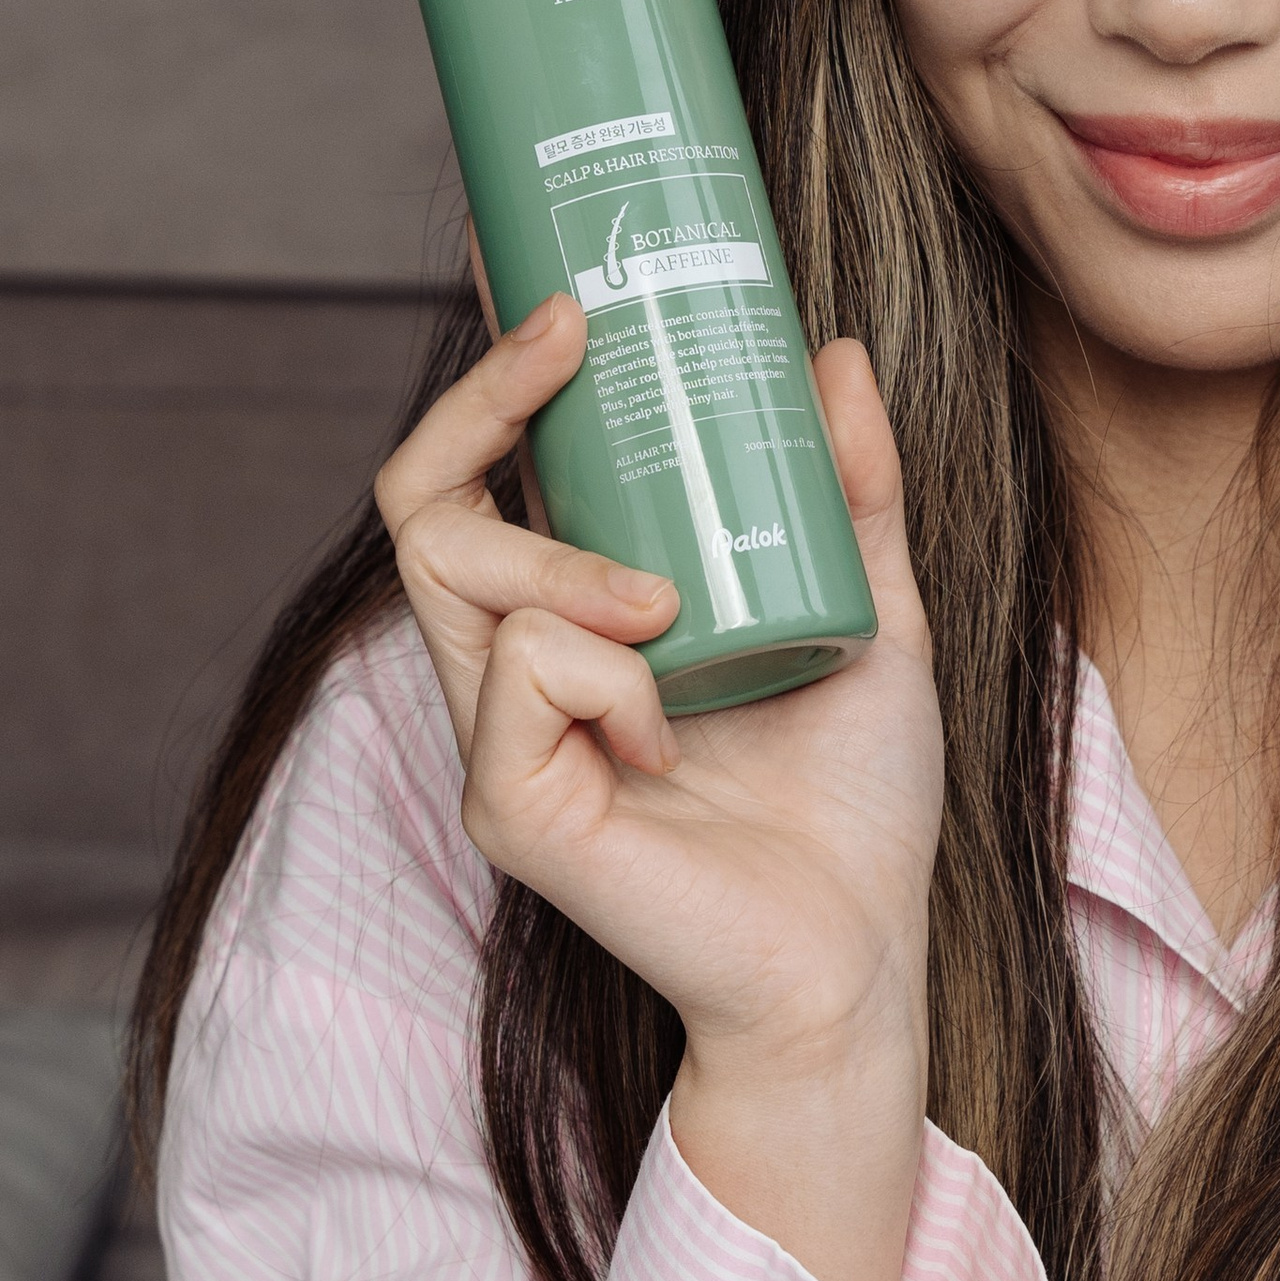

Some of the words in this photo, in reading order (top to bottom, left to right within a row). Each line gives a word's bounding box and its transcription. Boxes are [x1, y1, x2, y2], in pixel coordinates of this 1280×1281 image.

[543, 140, 569, 160] 탈모
[571, 130, 597, 149] 증상
[598, 124, 625, 142] 완화
[628, 117, 667, 136] 기능성
[544, 165, 591, 193] SCALP
[593, 162, 605, 176] &
[604, 152, 648, 173] HAIR
[648, 145, 740, 164] RESTORATION
[630, 221, 741, 252] BOTANICAL
[638, 247, 734, 277] CAFFEINE
[586, 338, 603, 351] The
[605, 325, 637, 345] liquid
[696, 308, 739, 321] contains
[740, 305, 782, 318] functional
[589, 341, 650, 367] ingredients
[677, 324, 727, 341] botanical
[729, 322, 769, 333] caffeine,
[593, 356, 657, 385] penetrating
[677, 344, 706, 358] scalp
[707, 339, 744, 353] quickly
[746, 339, 755, 348] to
[757, 338, 787, 348] nourish
[597, 386, 614, 398] the
[615, 378, 638, 391] hair
[692, 358, 717, 371] help
[719, 356, 752, 367] reduce
[754, 353, 771, 363] hair
[601, 399, 627, 414] Plus,
[683, 373, 733, 390] nutrients
[735, 369, 786, 382] strengthen
[605, 418, 623, 430] the
[624, 407, 652, 423] scalp
[712, 388, 738, 401] hair.
[616, 455, 634, 469] ALL
[634, 446, 660, 462] HAIR
[744, 438, 775, 453] 300ml
[781, 439, 798, 449] 10.1
[619, 462, 662, 484] SULFATE
